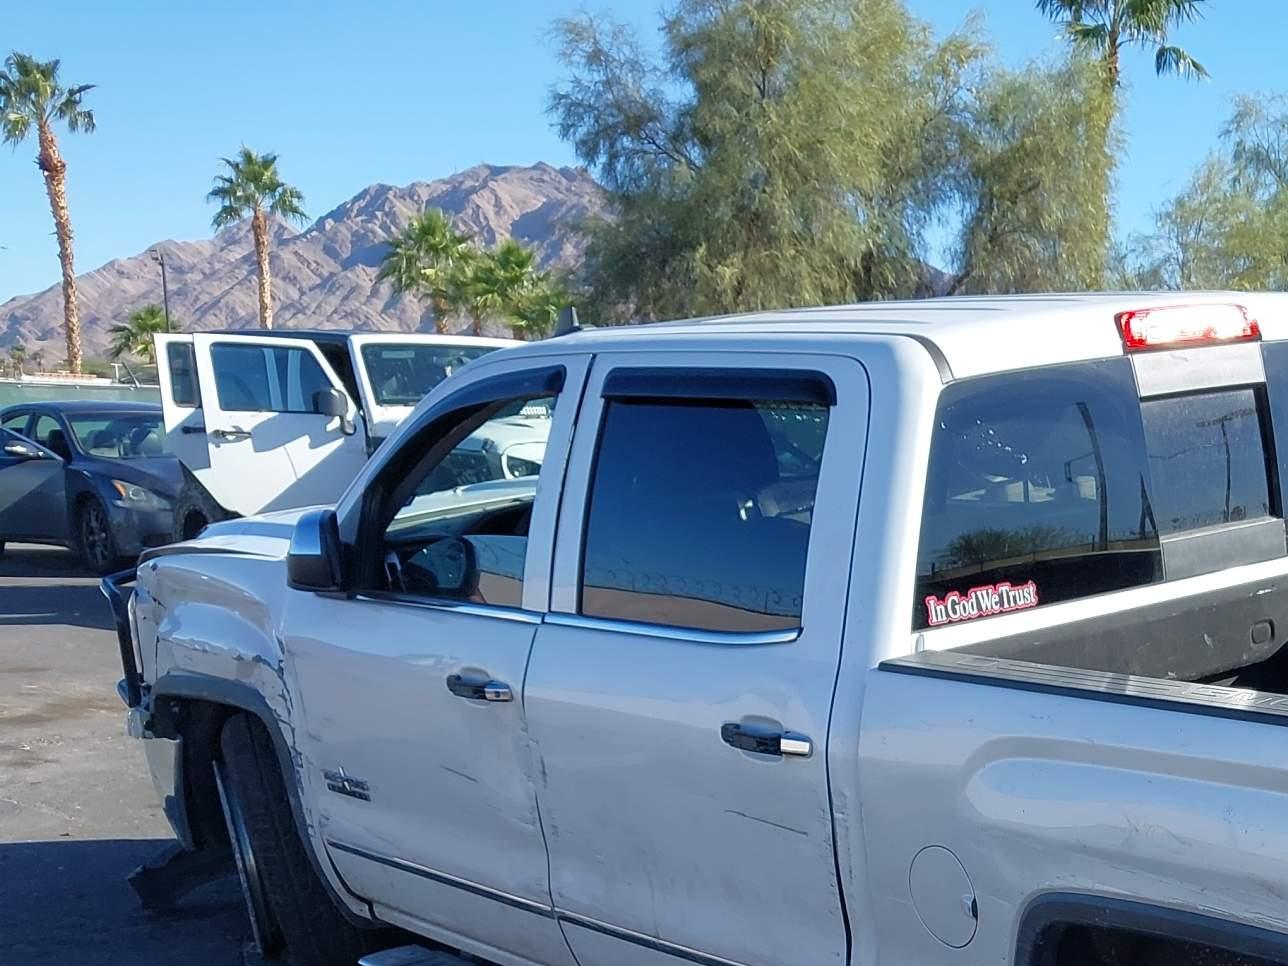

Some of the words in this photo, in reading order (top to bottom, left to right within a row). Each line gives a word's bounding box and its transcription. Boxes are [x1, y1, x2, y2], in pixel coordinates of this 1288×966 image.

[928, 599, 947, 623] In
[947, 591, 978, 619] God
[976, 586, 1000, 612] We
[999, 583, 1036, 609] Trust
